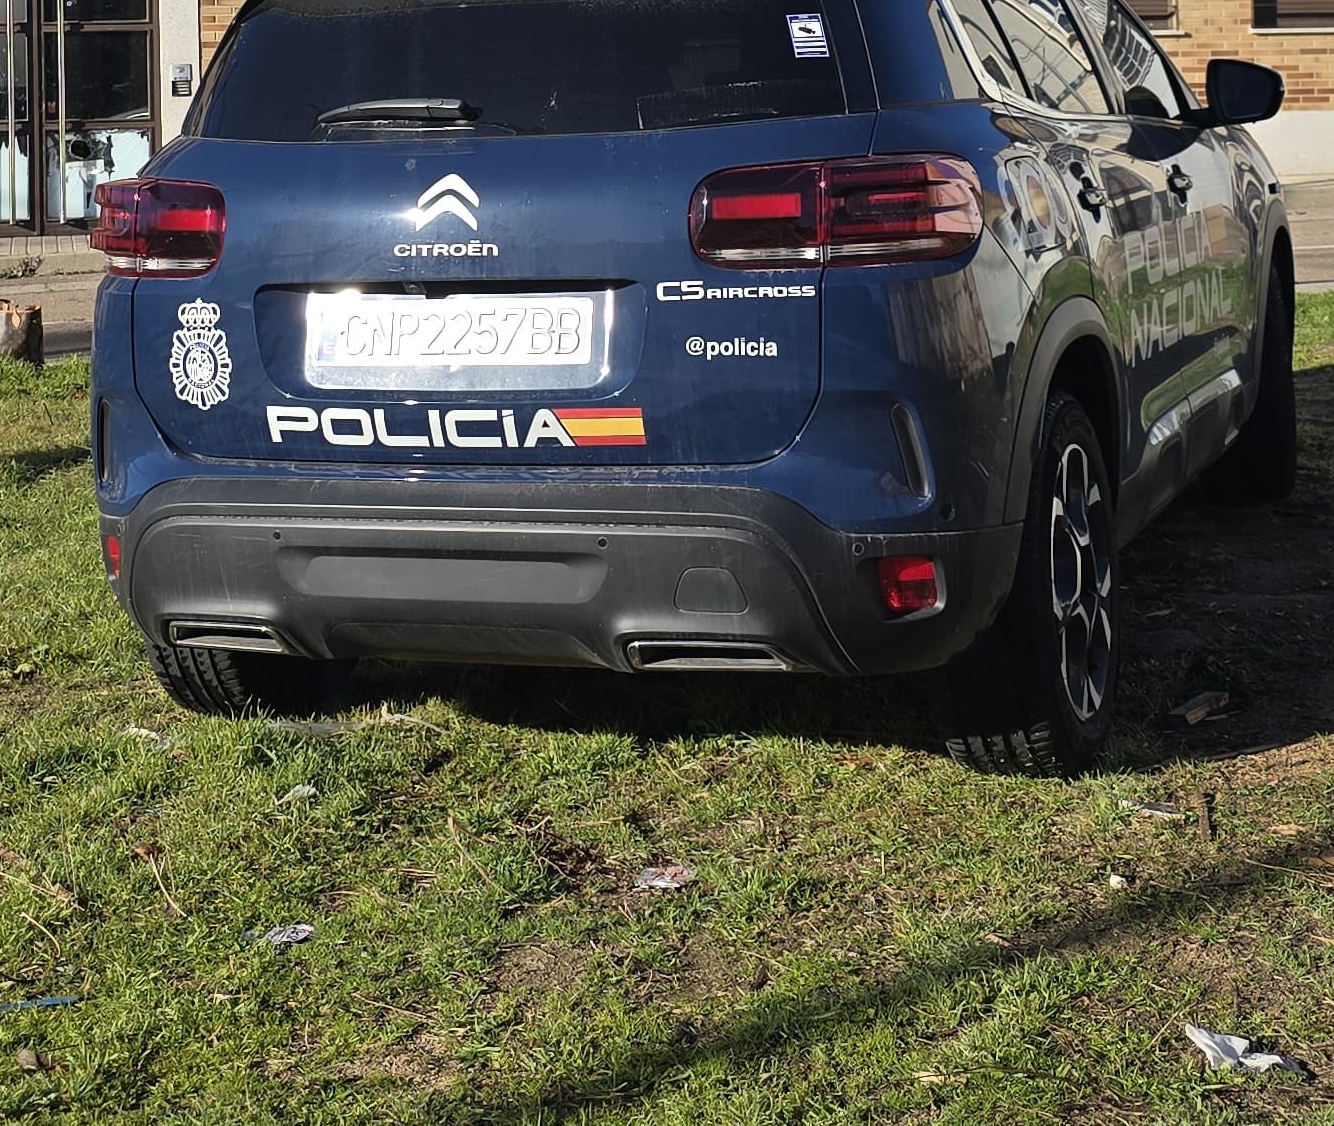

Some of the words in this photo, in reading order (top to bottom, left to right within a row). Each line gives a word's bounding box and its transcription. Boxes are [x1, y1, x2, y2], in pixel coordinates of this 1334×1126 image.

[656, 280, 704, 301] C5
[706, 285, 816, 299] AIRCROSS
[1130, 269, 1233, 368] NACIONAL
[685, 336, 778, 361] @policia
